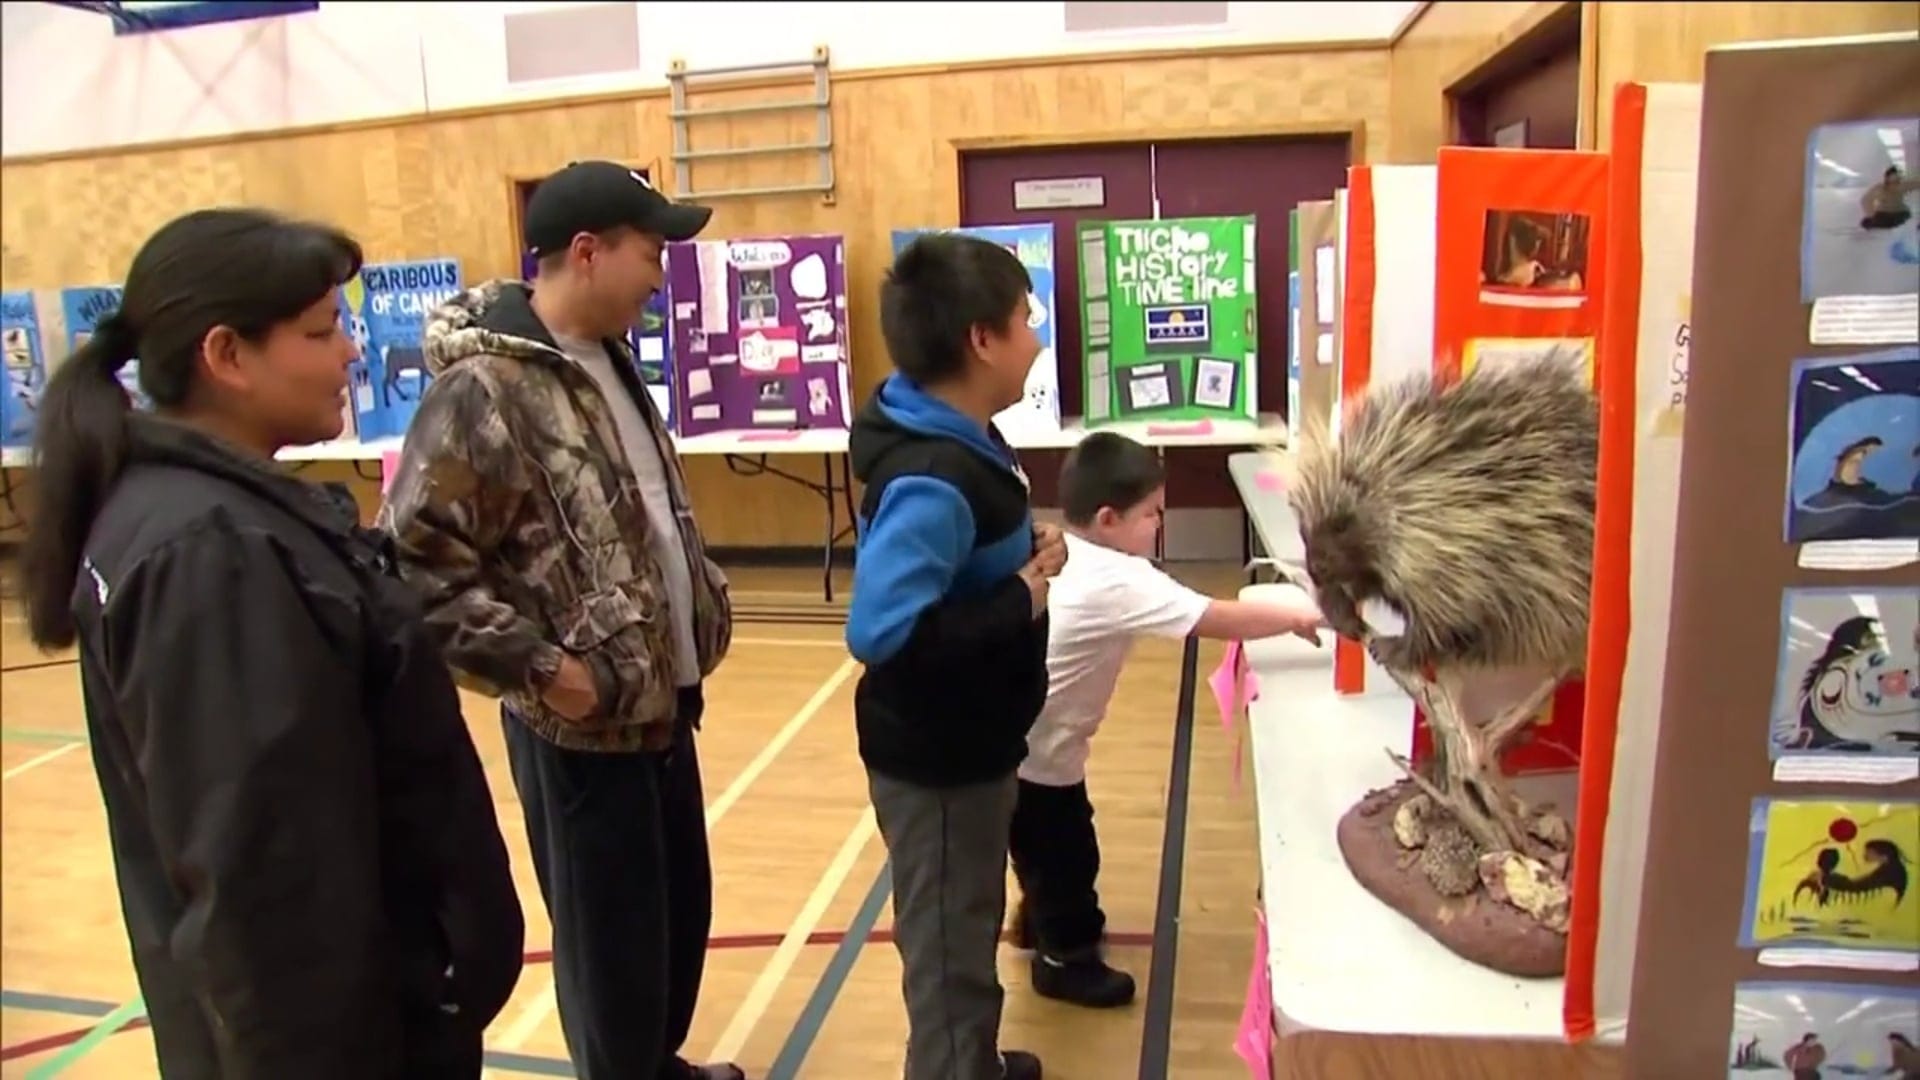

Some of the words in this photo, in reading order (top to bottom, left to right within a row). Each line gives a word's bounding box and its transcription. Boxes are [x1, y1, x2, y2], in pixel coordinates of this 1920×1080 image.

[366, 263, 456, 291] CARIBOUS
[1117, 275, 1184, 306] TIME
[371, 292, 393, 315] OF
